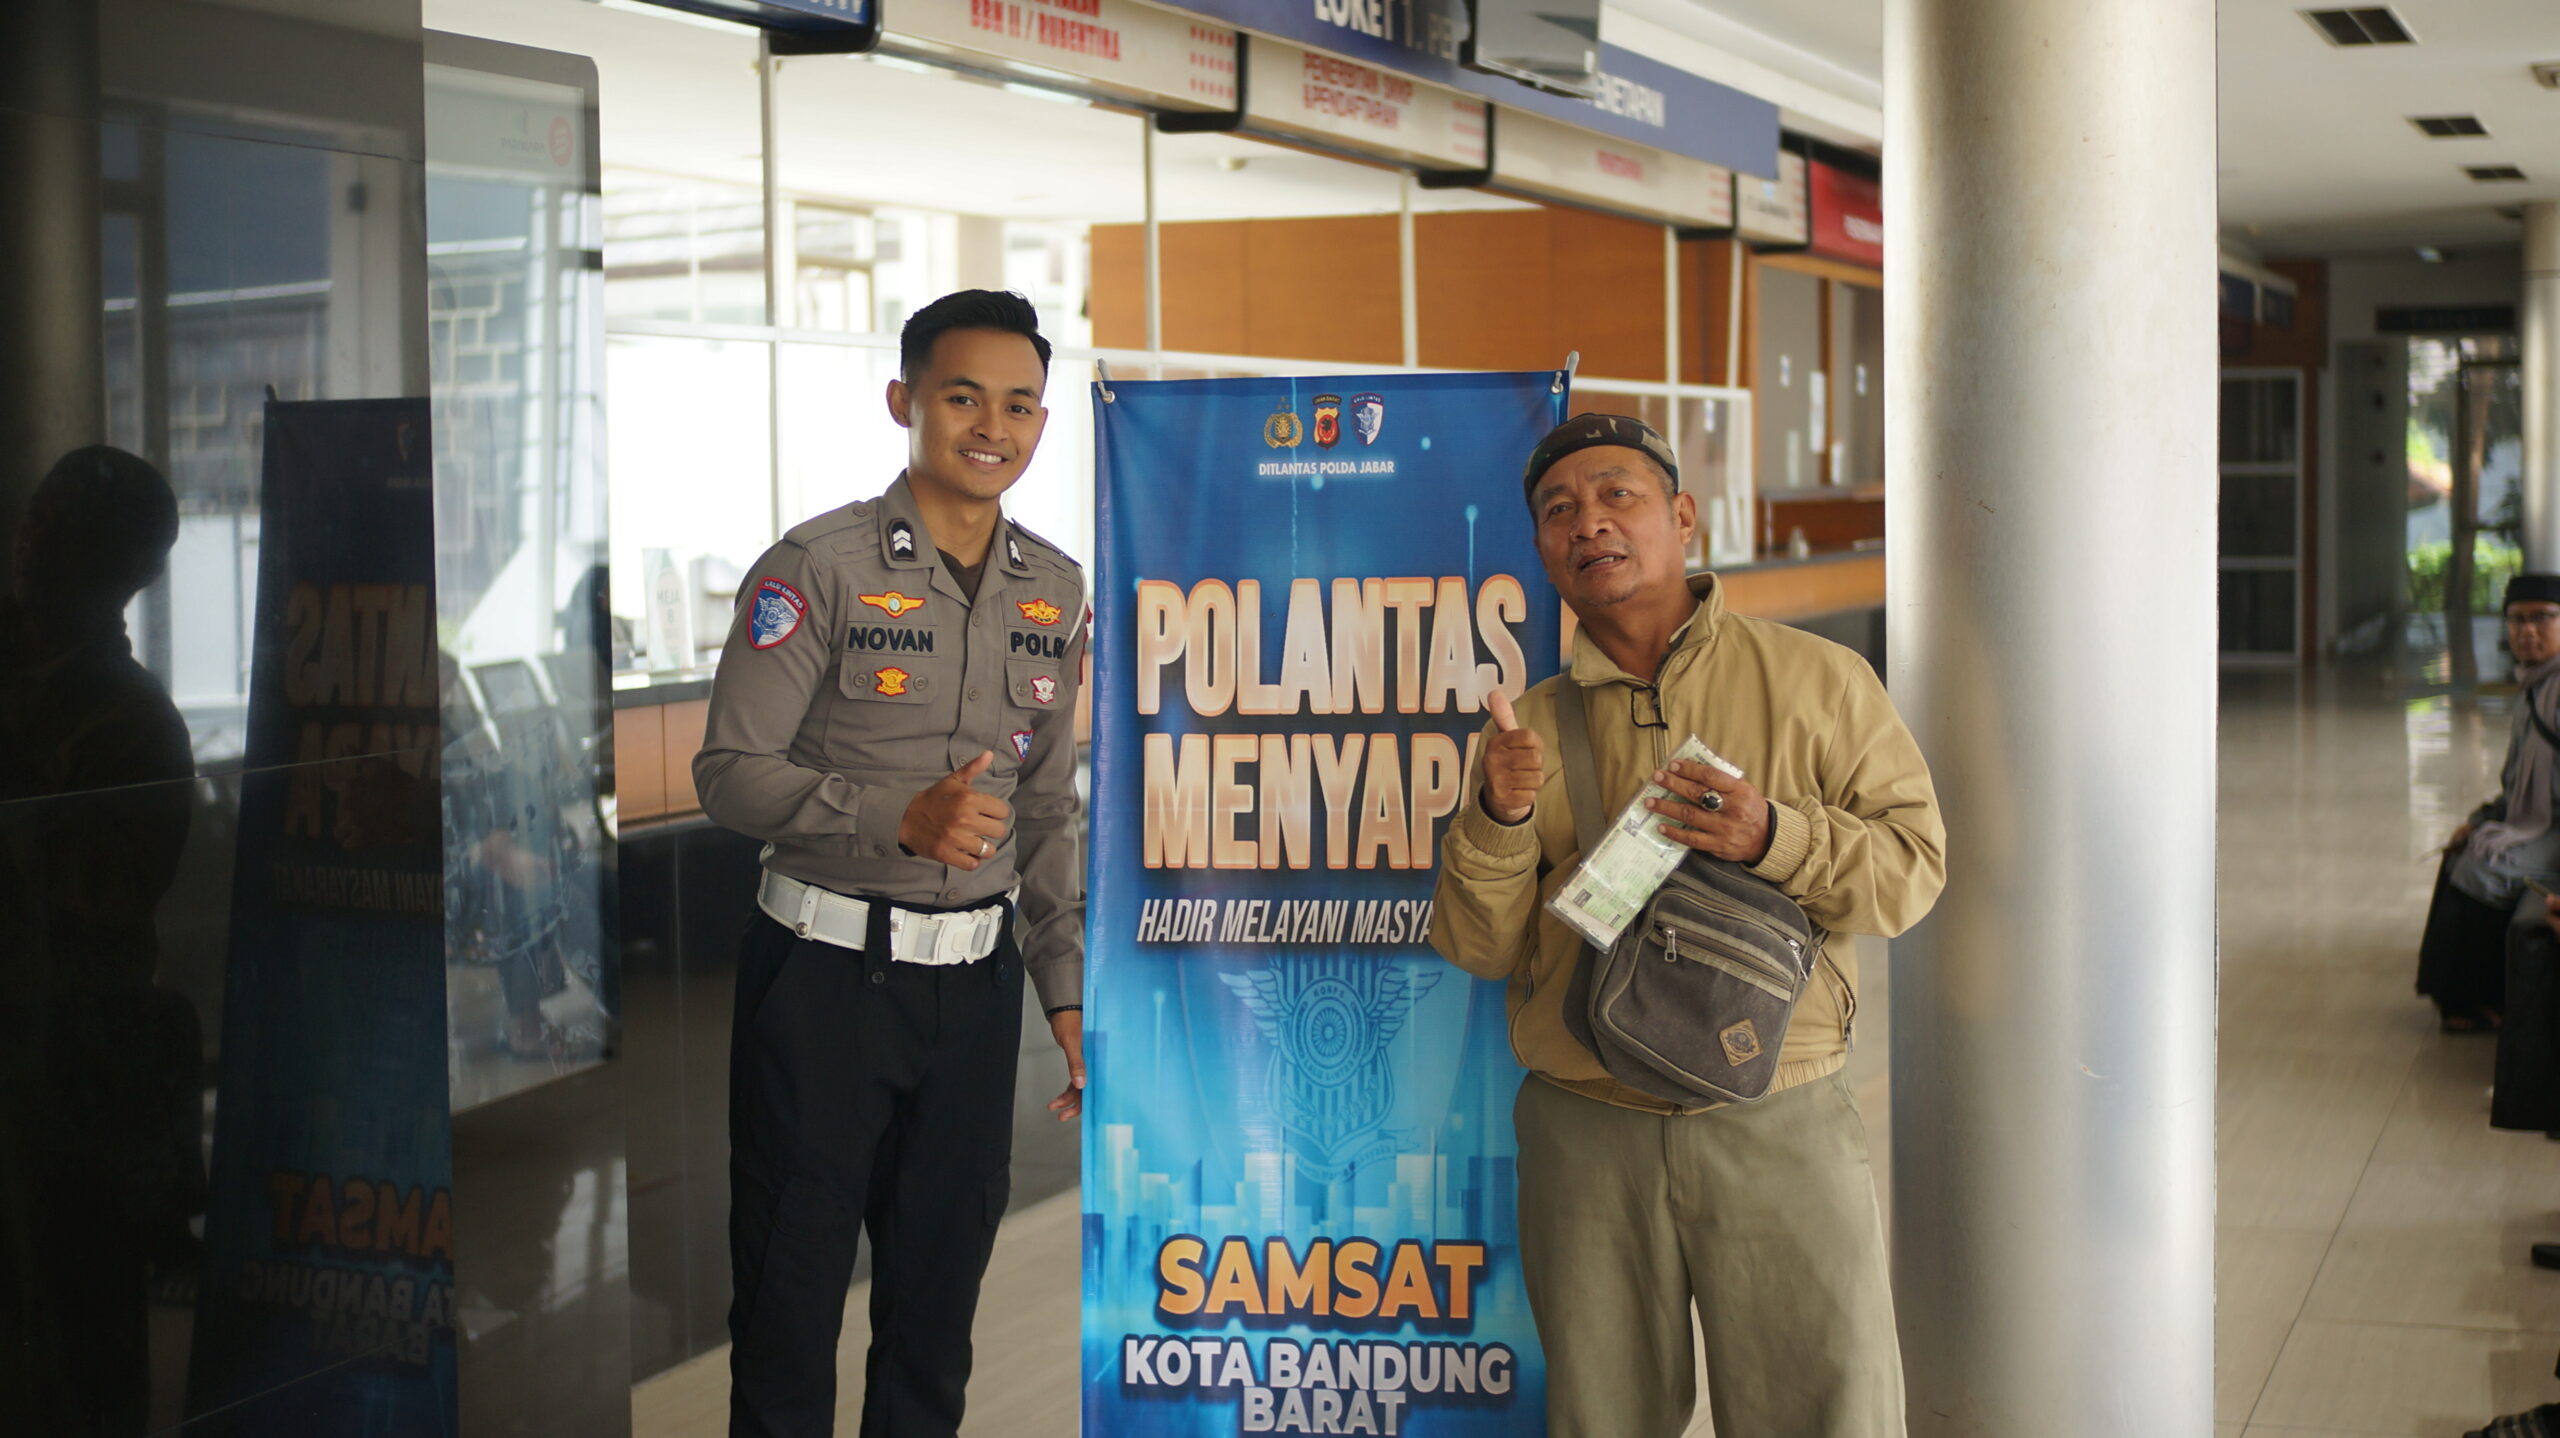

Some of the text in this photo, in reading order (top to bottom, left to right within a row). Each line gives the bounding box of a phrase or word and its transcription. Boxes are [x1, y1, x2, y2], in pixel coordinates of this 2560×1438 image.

[1258, 461, 1395, 475] DITLANTAS POLDA JABAR
[848, 627, 933, 653] NOVAN
[1137, 574, 1526, 716] POLANTAS
[1143, 733, 1481, 869] MENYAP
[1136, 899, 1434, 943] HADIR MELAYANI MASYA
[1159, 1238, 1484, 1319] SAMSAT
[1125, 1338, 1511, 1395] KOTA BANDUNG
[1243, 1386, 1406, 1436] BARAT
